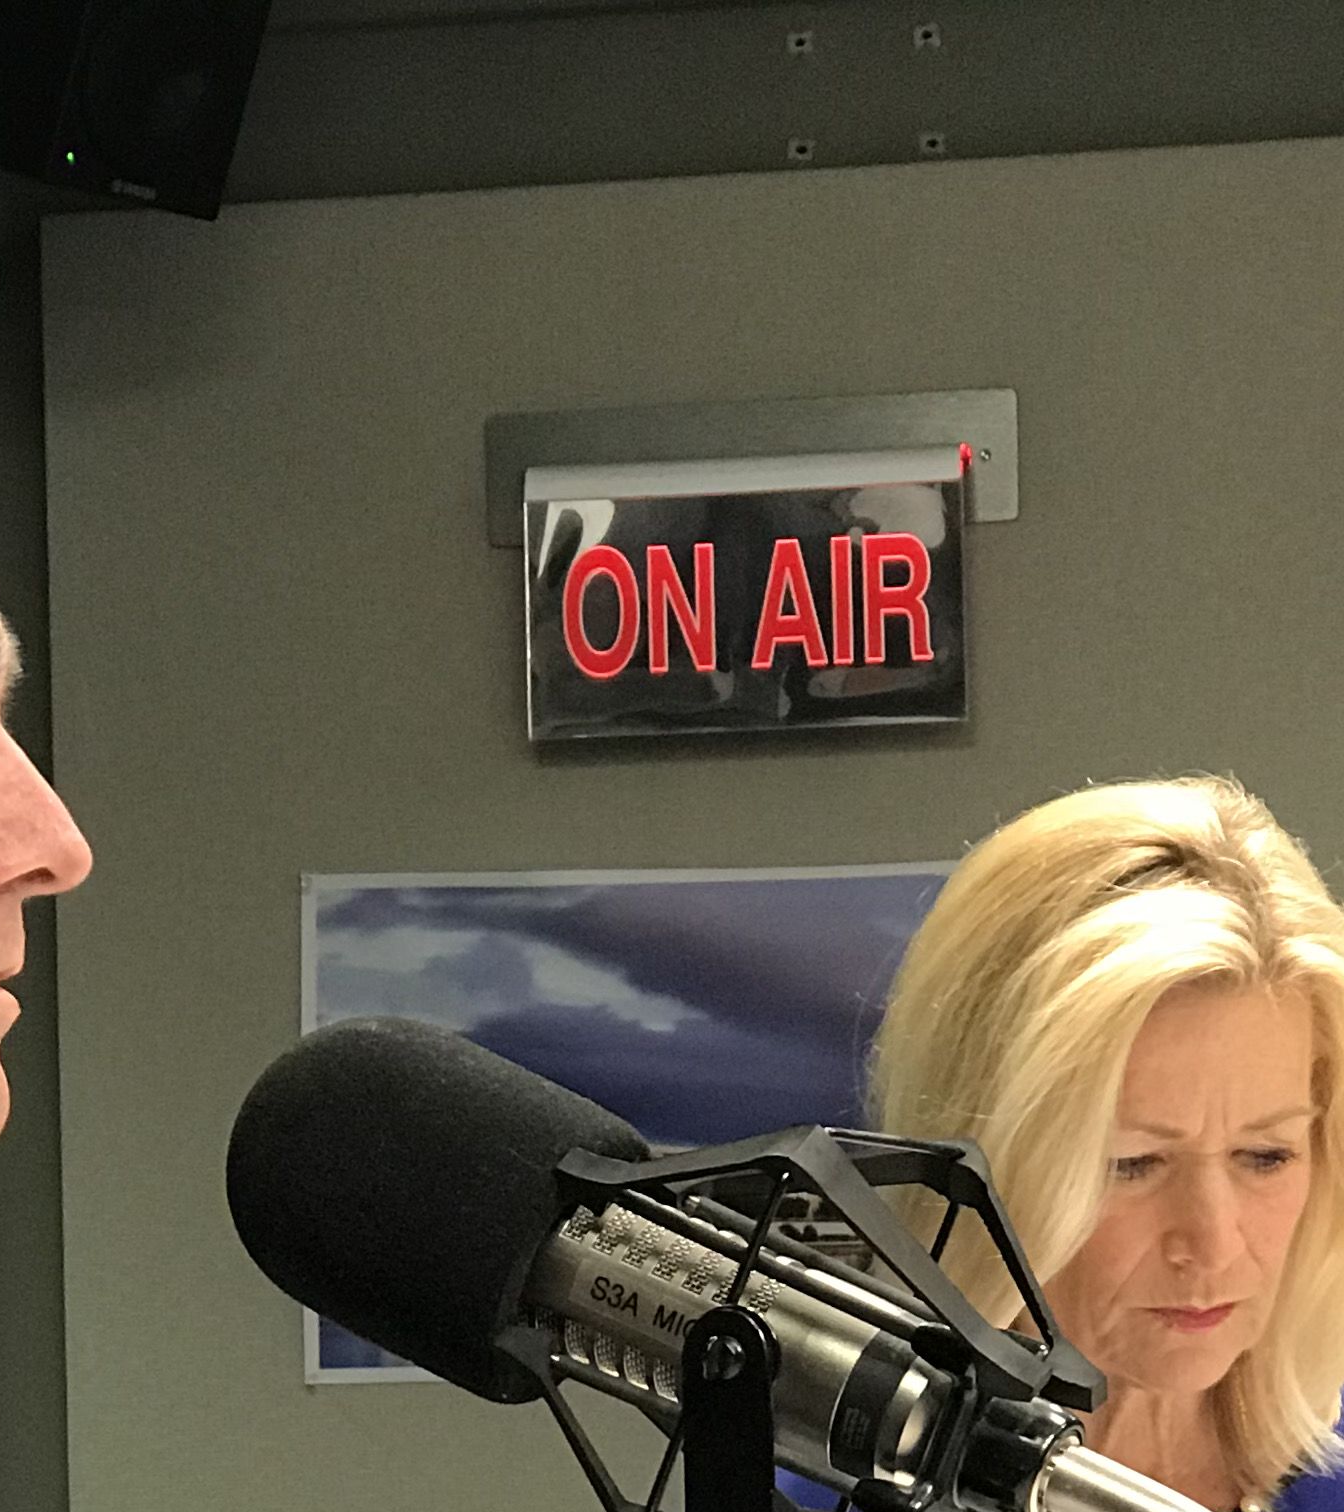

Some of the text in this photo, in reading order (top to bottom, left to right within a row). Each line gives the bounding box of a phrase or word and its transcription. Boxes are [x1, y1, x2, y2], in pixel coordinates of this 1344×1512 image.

[563, 532, 935, 679] ON AIR
[590, 1276, 639, 1318] S3A
